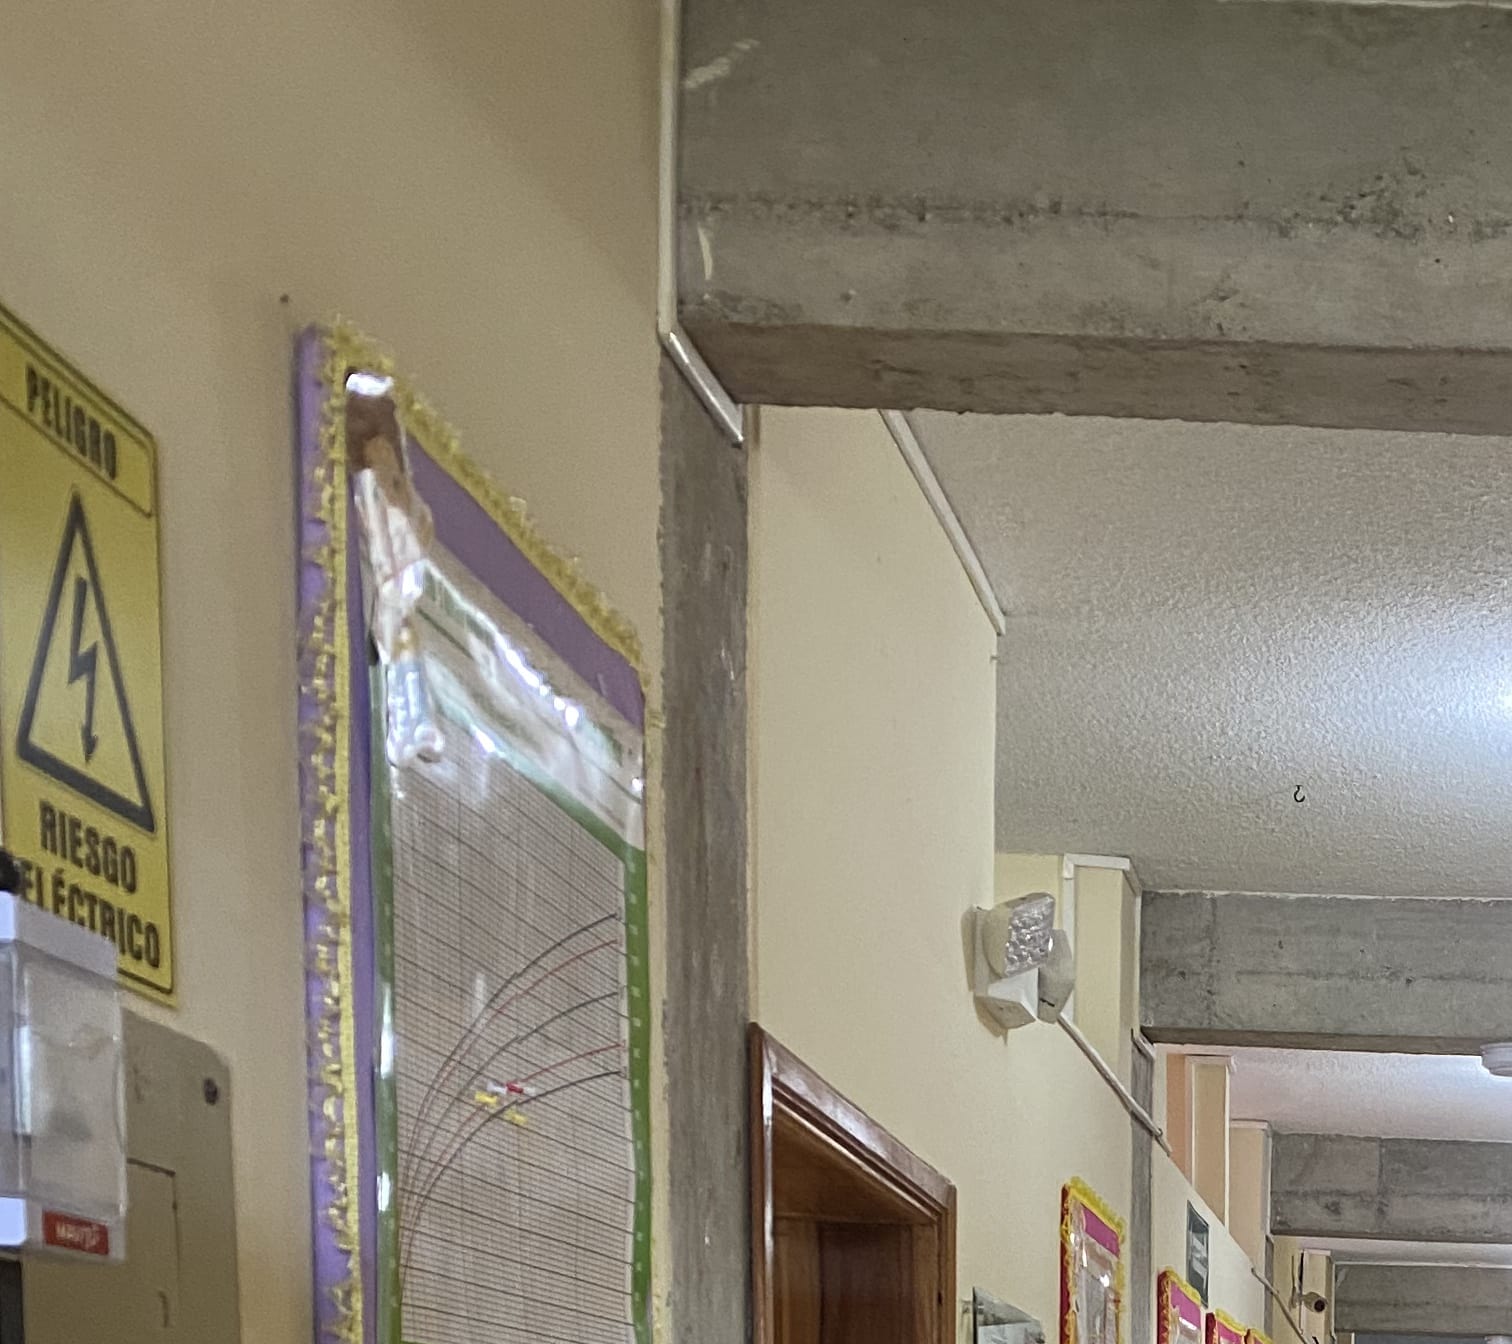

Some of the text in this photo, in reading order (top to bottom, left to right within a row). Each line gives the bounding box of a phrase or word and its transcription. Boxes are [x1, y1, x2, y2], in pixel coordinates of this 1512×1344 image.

[26, 362, 117, 480] PELIGRO
[39, 799, 137, 893] RIESGO
[20, 858, 160, 968] ELÉCTRICO
